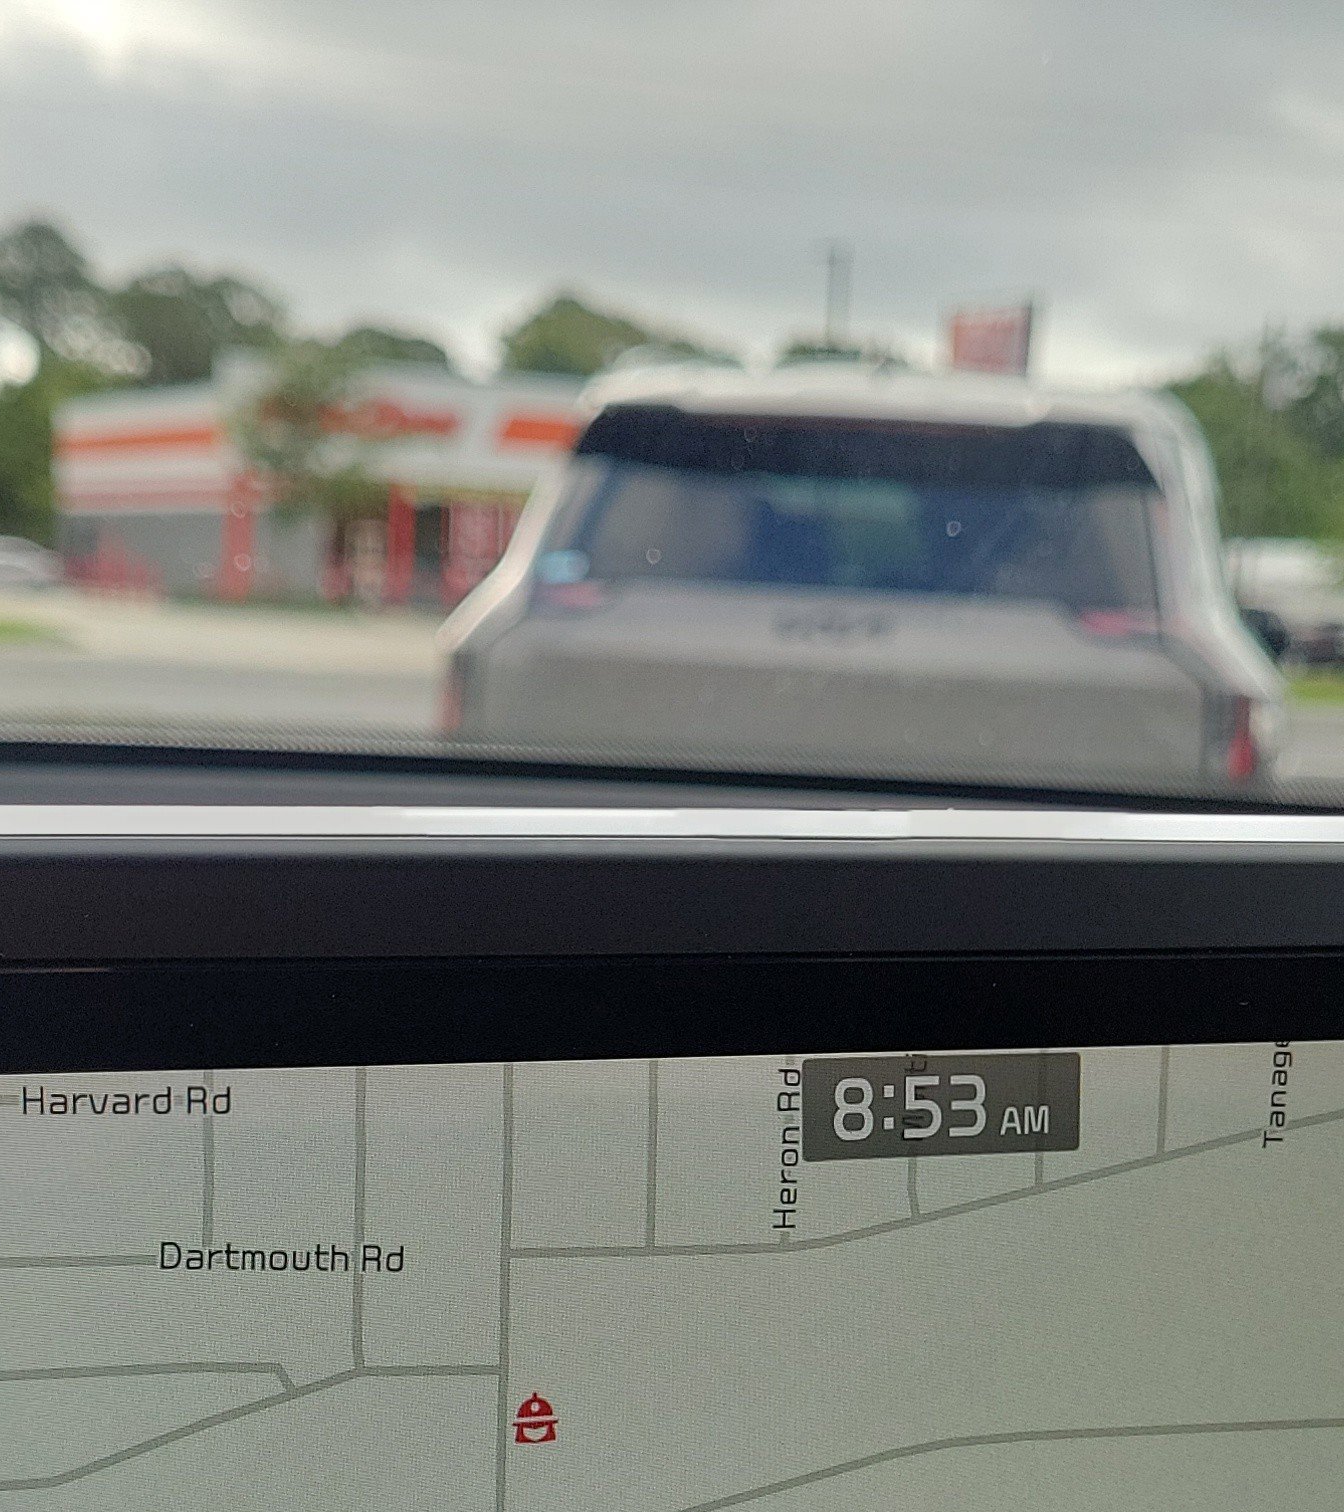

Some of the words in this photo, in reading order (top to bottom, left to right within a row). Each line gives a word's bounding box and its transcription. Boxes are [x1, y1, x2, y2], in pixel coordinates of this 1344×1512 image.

[20, 1085, 173, 1116] Harvard
[184, 1084, 233, 1115] Rd
[777, 1066, 802, 1112] Rd
[833, 1074, 988, 1141] 8:53
[1000, 1104, 1050, 1136] AM
[771, 1123, 798, 1230] Heron
[158, 1240, 349, 1273] Dartmouth
[361, 1242, 406, 1273] Rd
